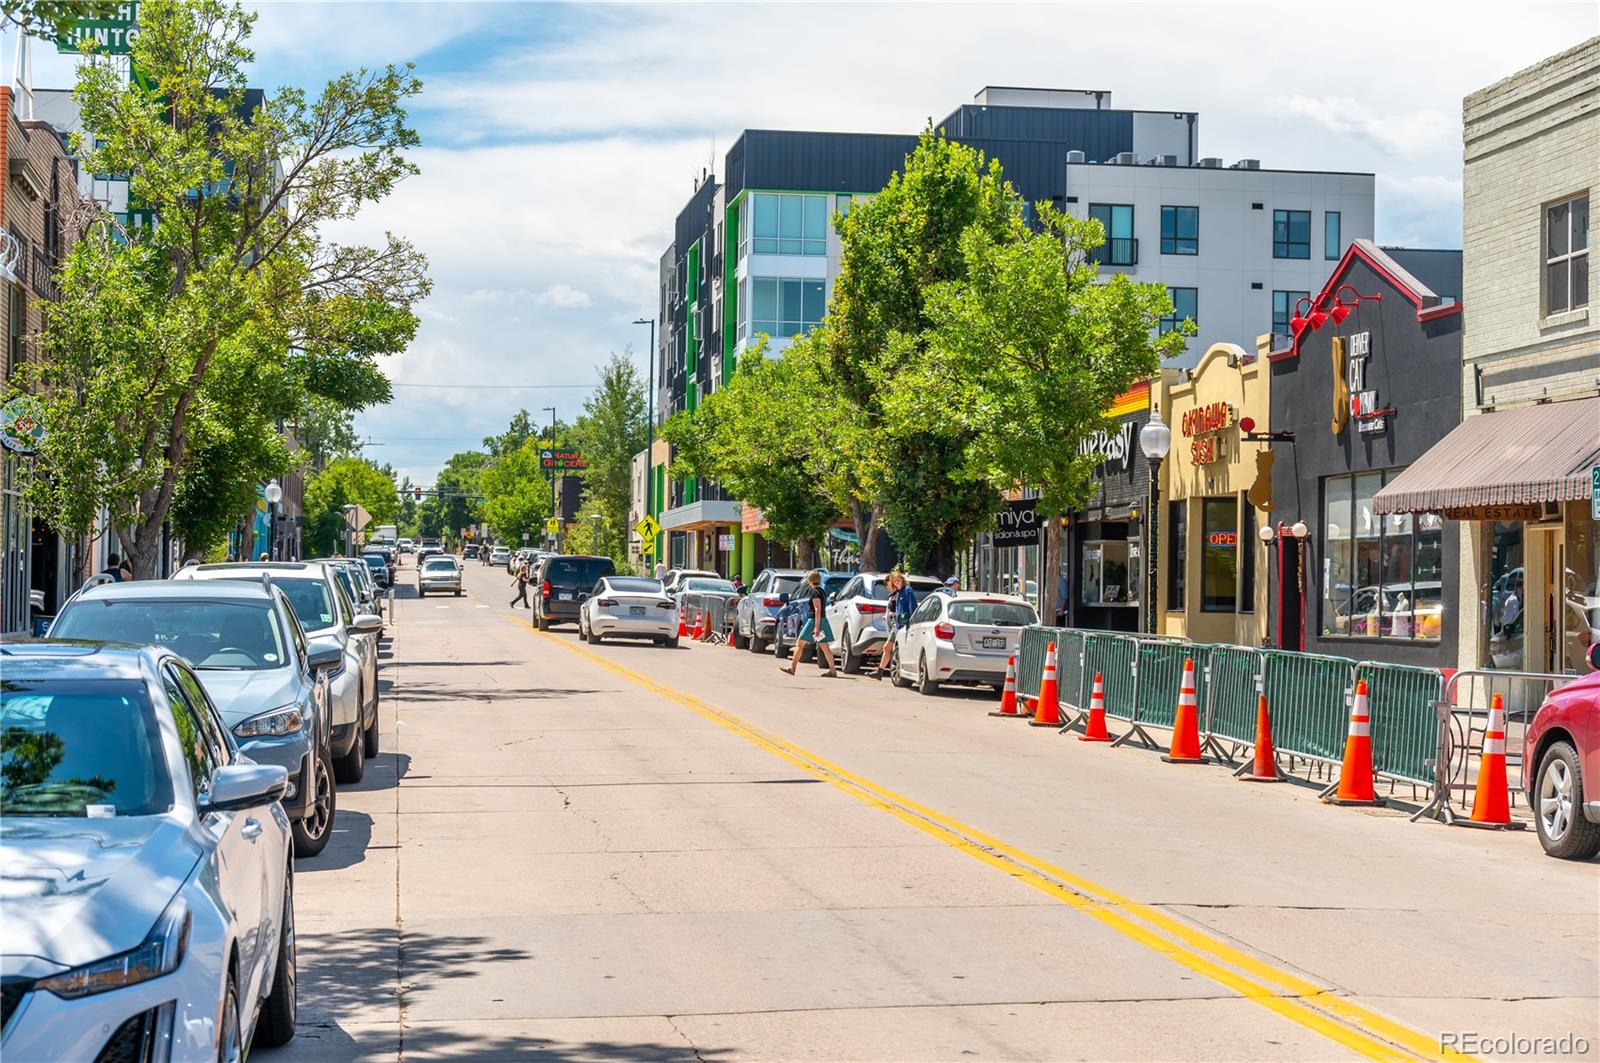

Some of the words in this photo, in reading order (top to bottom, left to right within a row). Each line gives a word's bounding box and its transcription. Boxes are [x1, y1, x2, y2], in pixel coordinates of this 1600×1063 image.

[1349, 358, 1364, 393] CAT
[1182, 401, 1227, 437] OKINAWA
[997, 507, 1035, 529] miya
[1445, 505, 1479, 518] REAL
[1484, 506, 1541, 518] ESTATE
